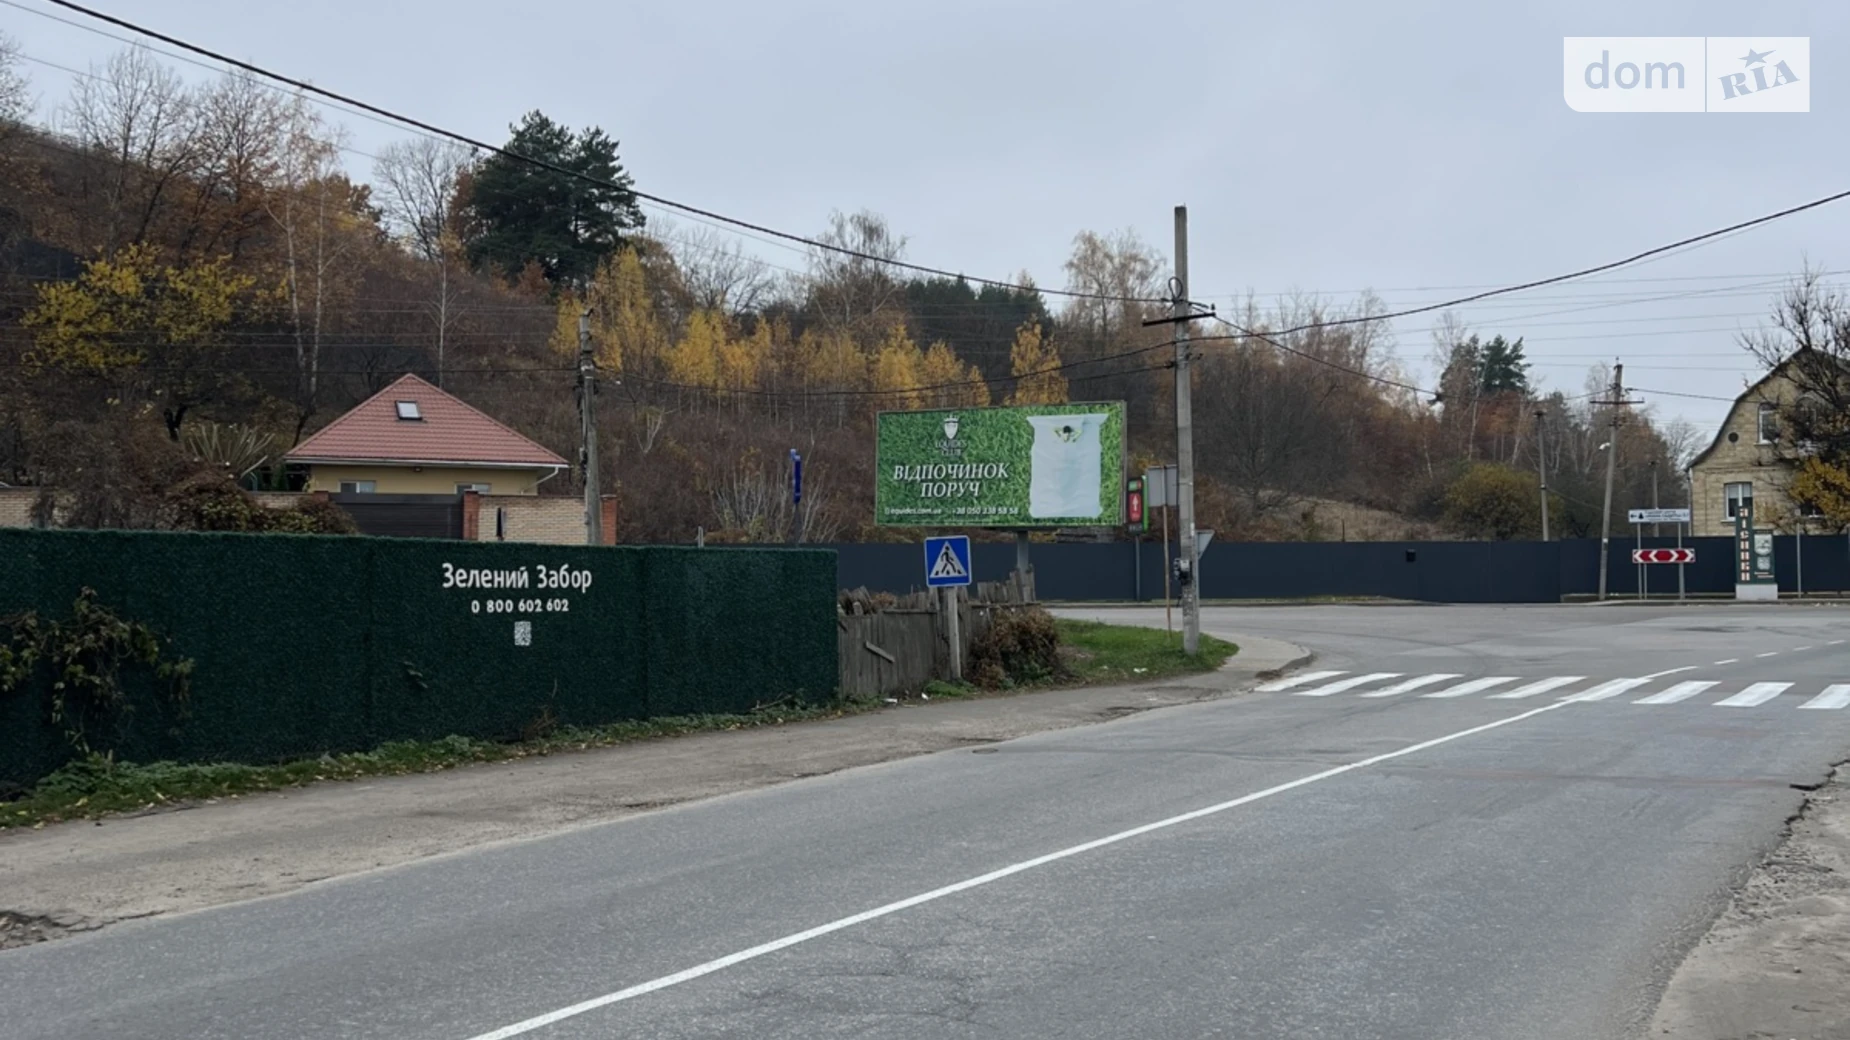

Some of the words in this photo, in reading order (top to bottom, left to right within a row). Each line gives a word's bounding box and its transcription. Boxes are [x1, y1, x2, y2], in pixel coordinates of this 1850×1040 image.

[894, 463, 1009, 482] ВІДПОЧИНОК
[921, 482, 980, 497] ПОРУЧ
[441, 562, 529, 589] Зелений
[536, 563, 593, 594] Забор
[471, 599, 480, 614] 0
[486, 599, 514, 613] 800
[518, 598, 543, 613] 602
[546, 598, 570, 612] 602
